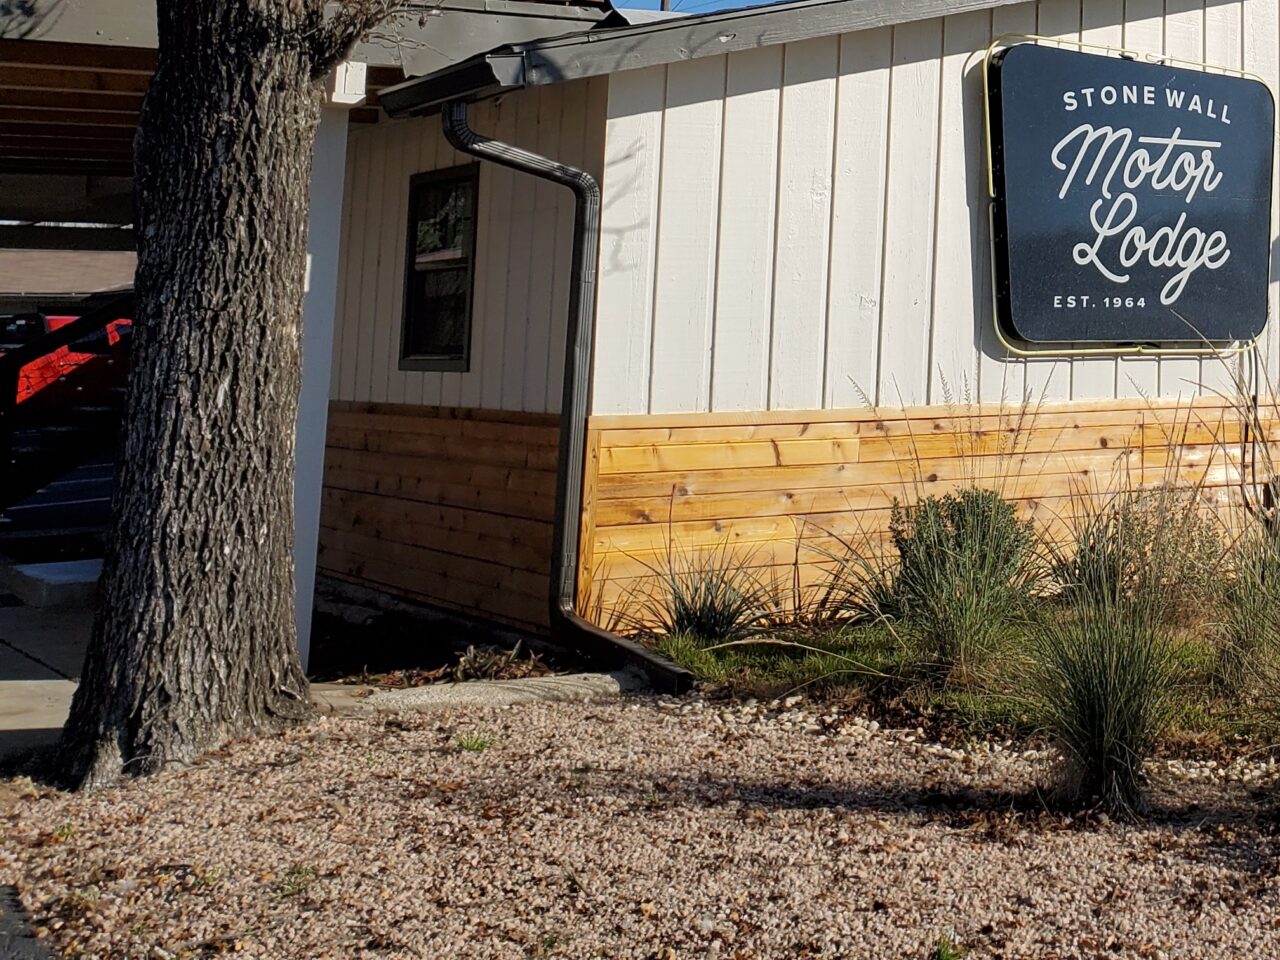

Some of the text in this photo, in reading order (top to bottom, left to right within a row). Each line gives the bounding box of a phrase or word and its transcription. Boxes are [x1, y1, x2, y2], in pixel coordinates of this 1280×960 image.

[1051, 123, 1224, 204] Motor
[1072, 192, 1231, 306] Lodge
[1053, 295, 1146, 308] EST. 1964
